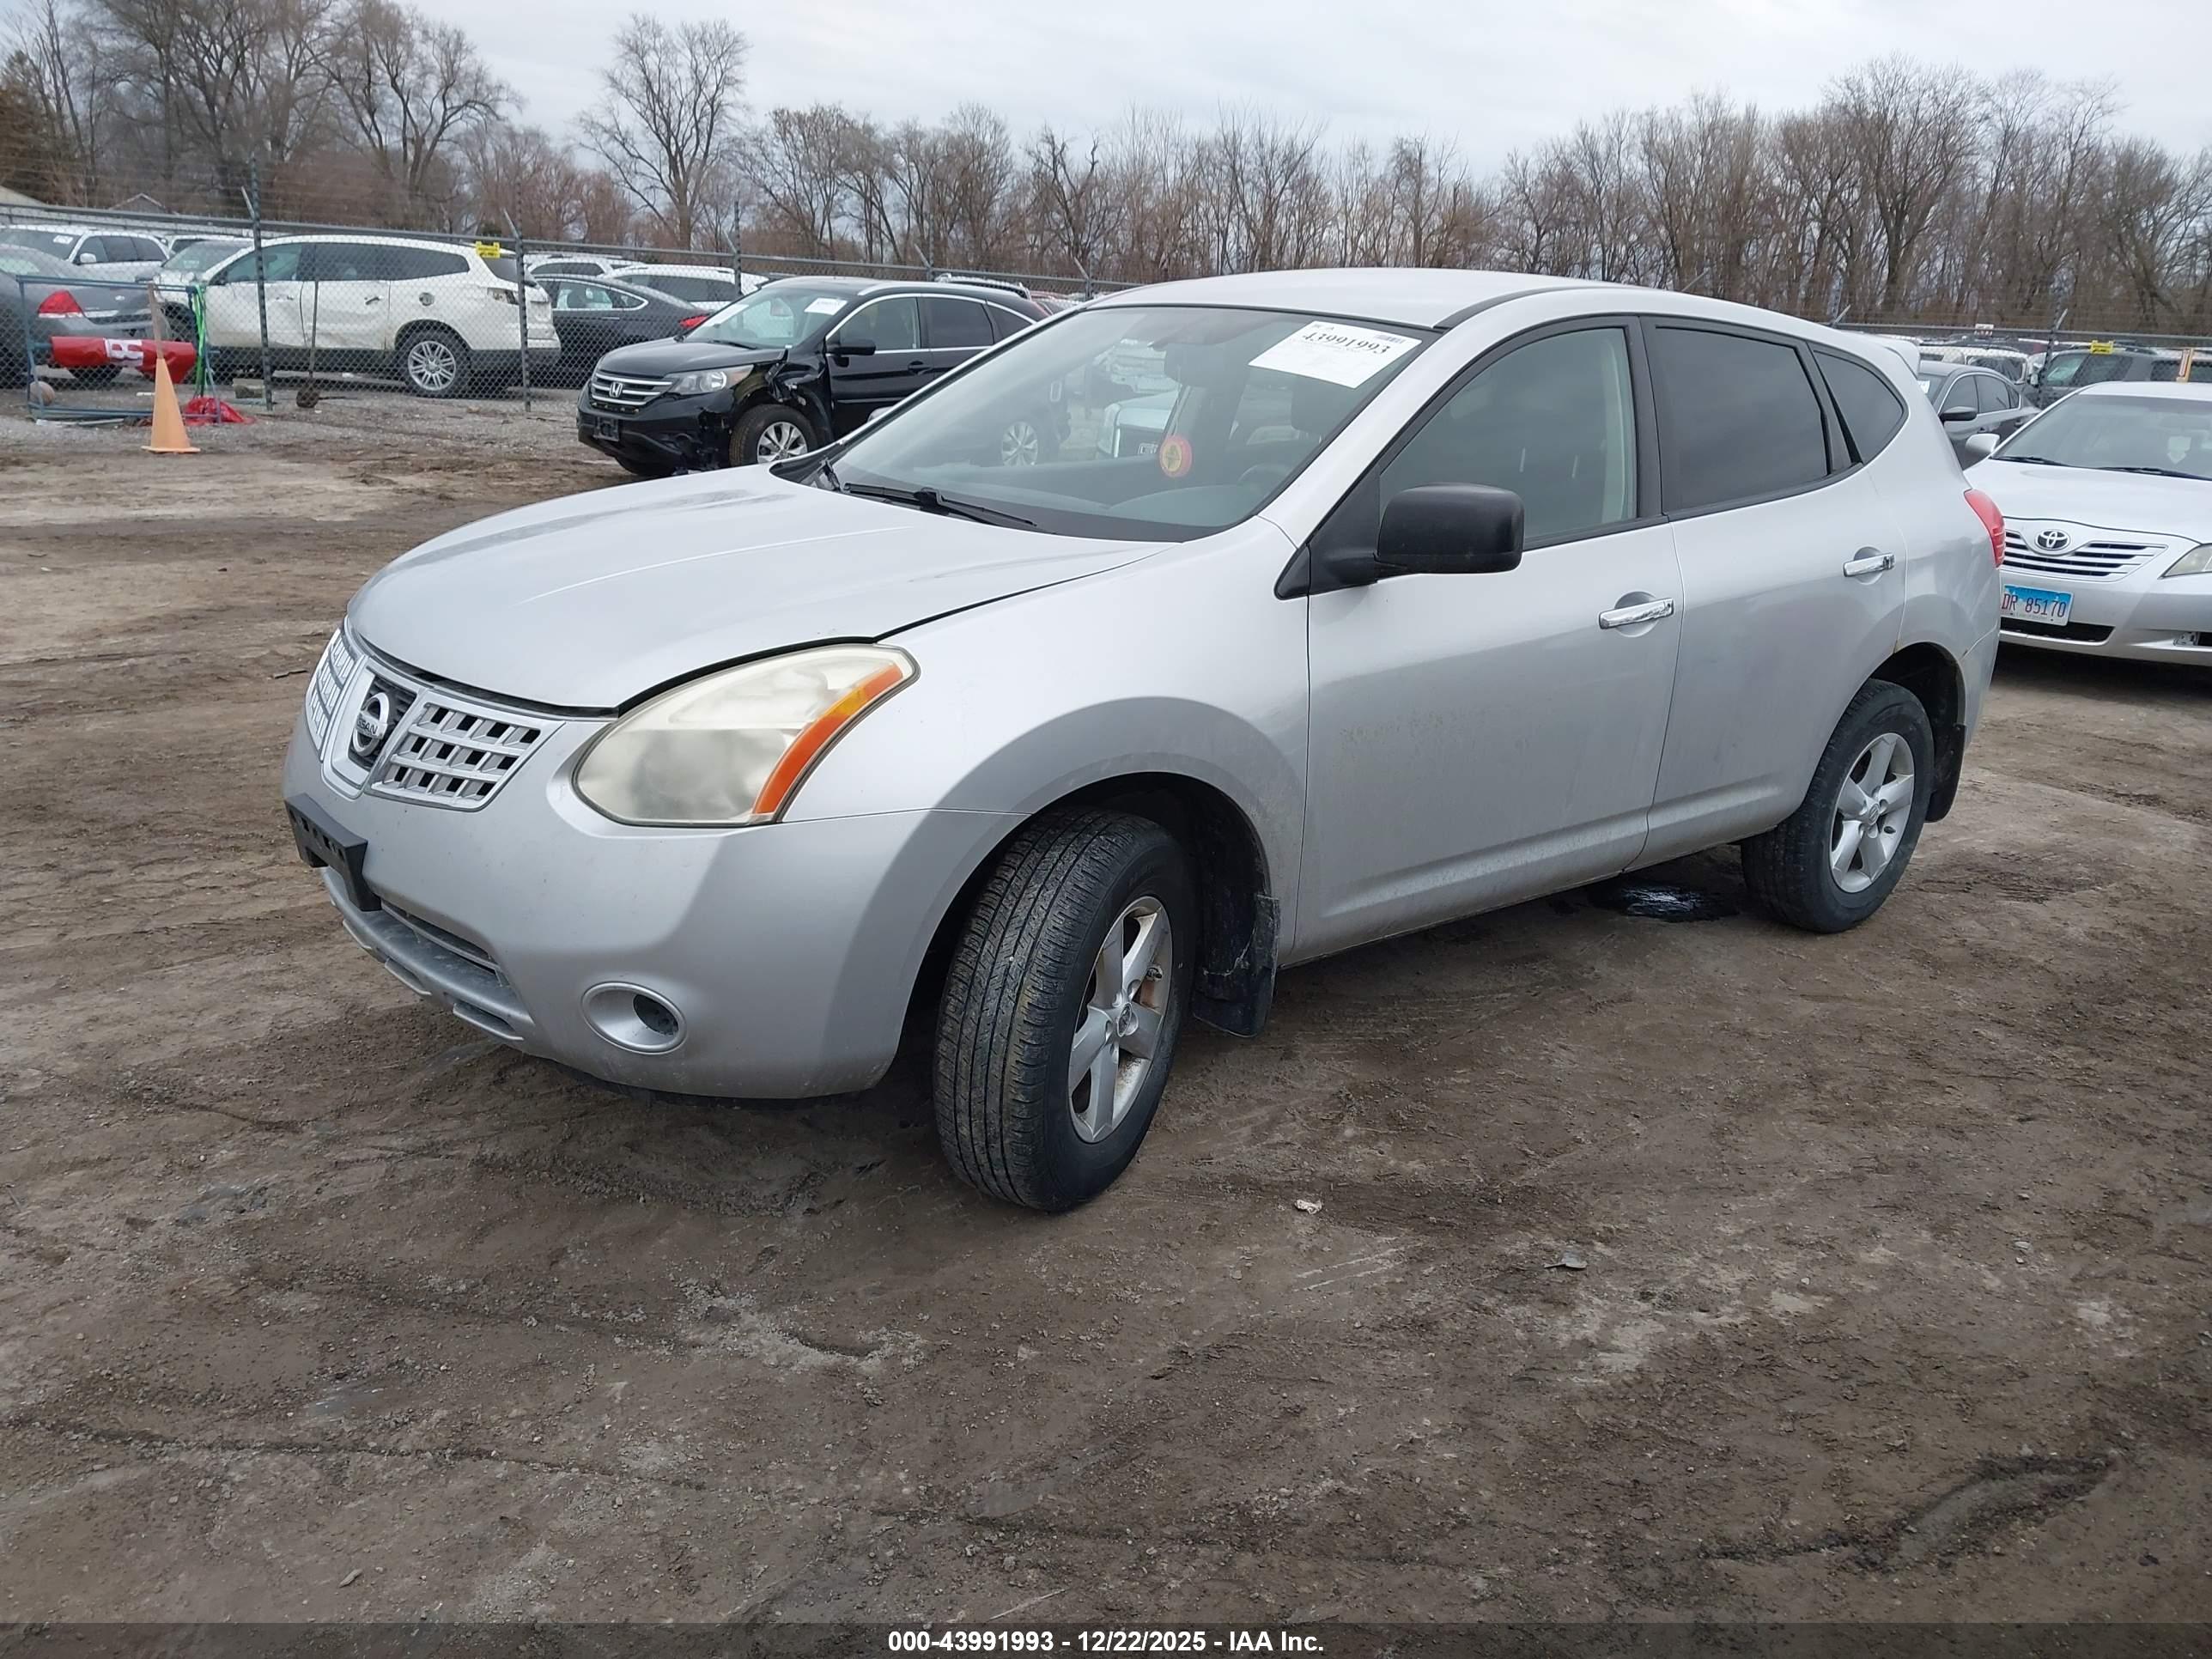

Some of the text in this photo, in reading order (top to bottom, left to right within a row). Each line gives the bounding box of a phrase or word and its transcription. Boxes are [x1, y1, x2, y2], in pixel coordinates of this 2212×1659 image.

[1302, 331, 1391, 354] 43991993
[2002, 593, 2067, 618] DR 85170
